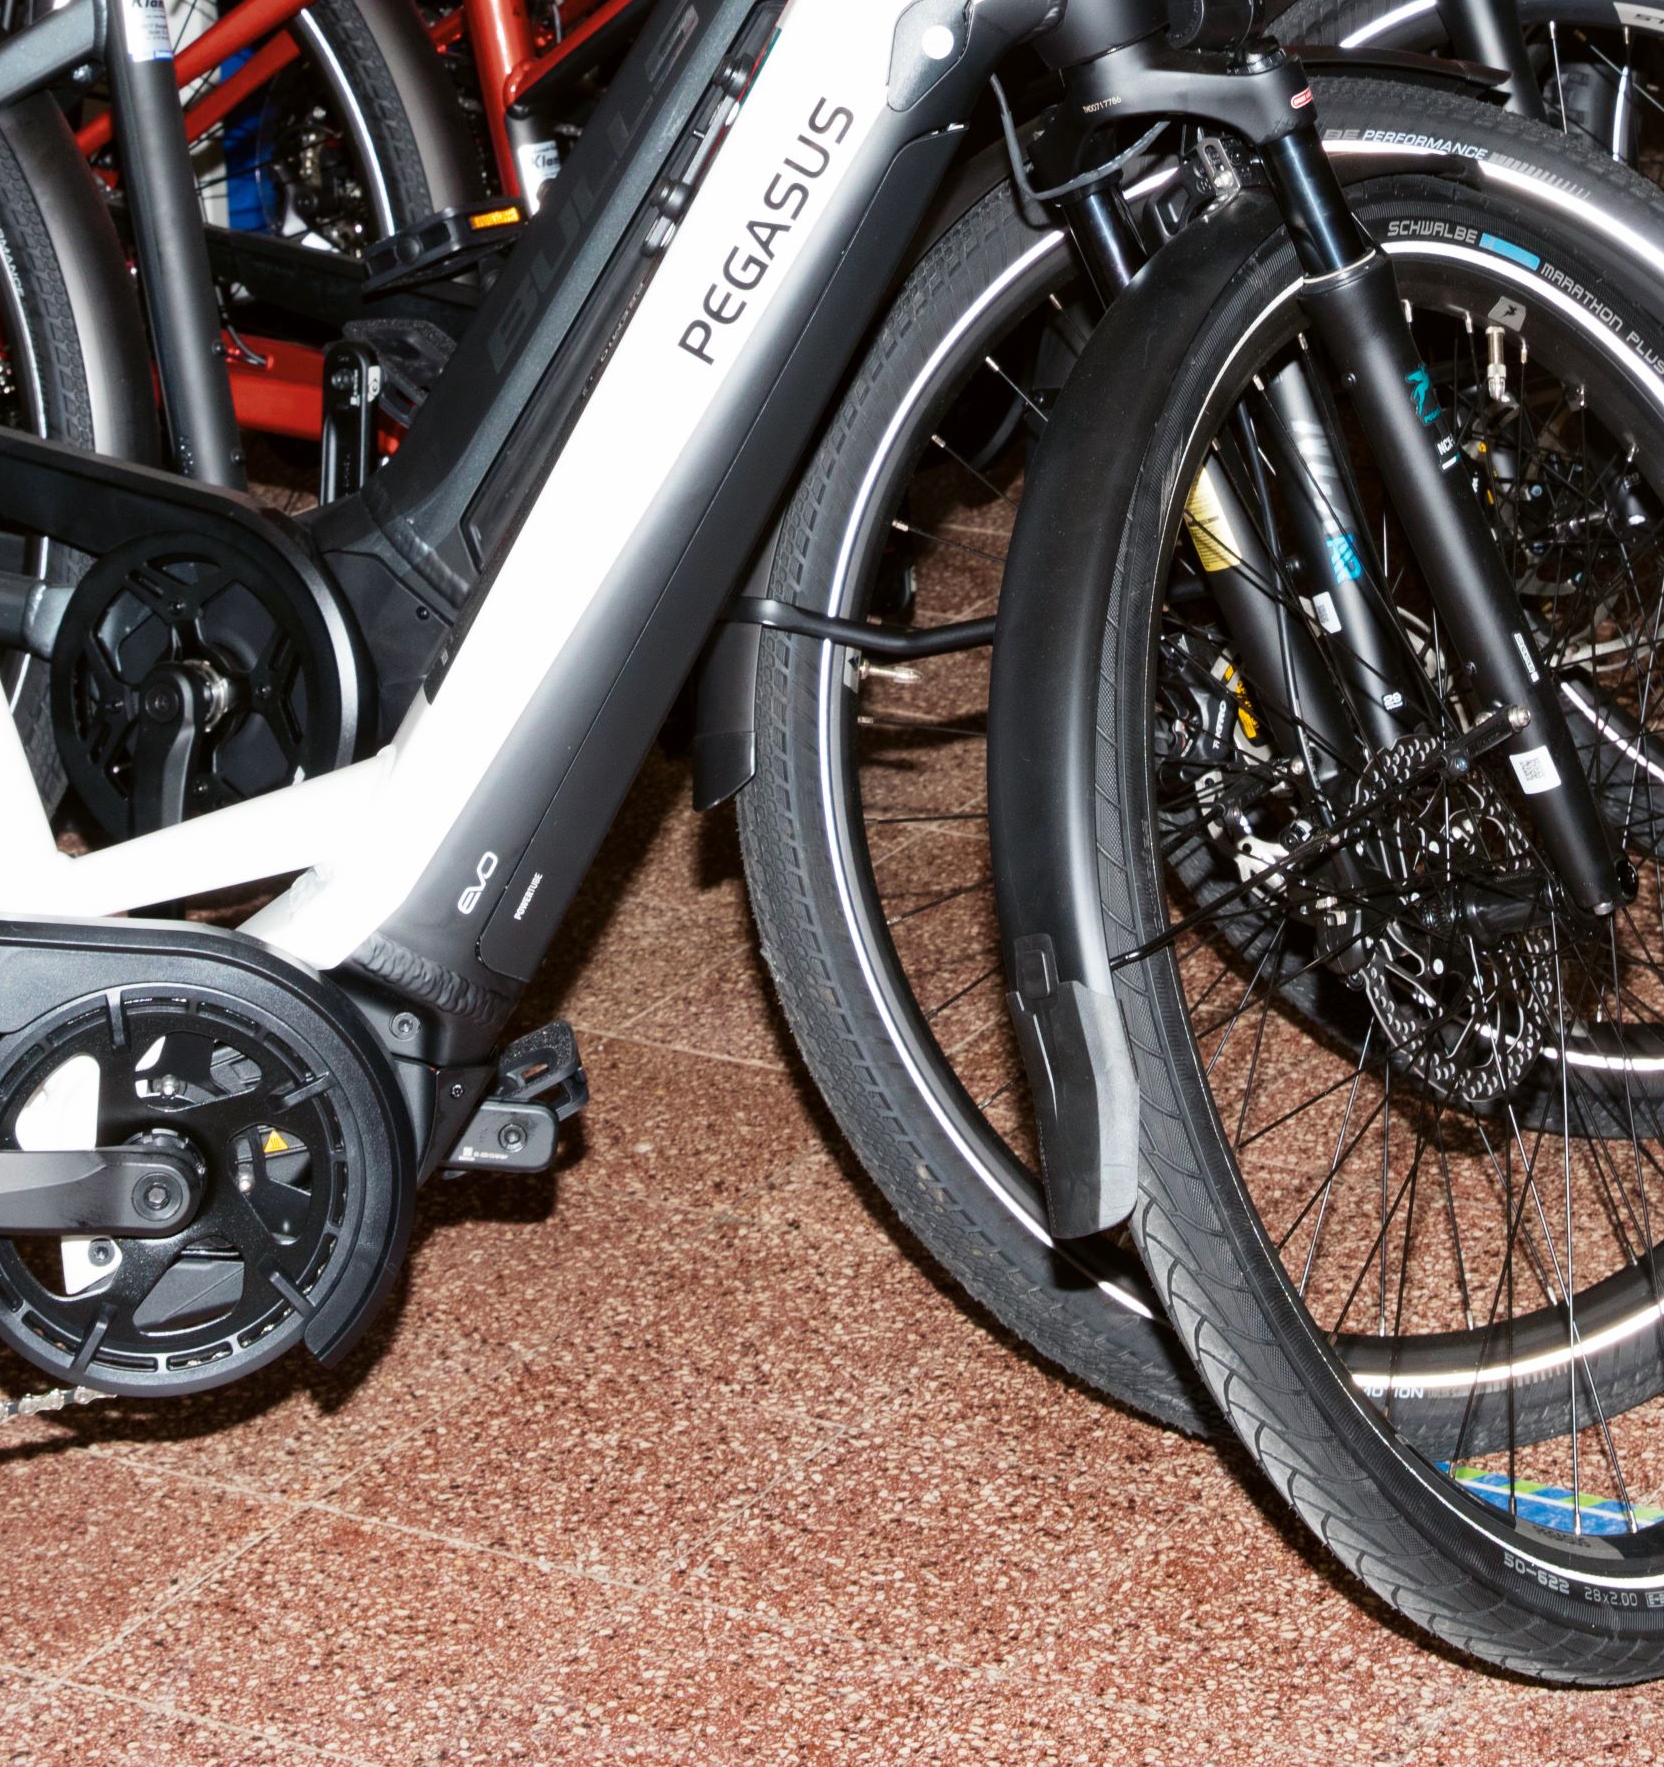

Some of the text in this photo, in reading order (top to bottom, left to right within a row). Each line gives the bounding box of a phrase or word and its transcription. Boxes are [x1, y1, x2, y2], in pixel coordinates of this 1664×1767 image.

[1362, 127, 1489, 162] PERFORMANCE
[677, 96, 855, 366] PEGASUS
[1387, 219, 1479, 246] SCHWALBE
[1539, 261, 1625, 333] MARATHON
[457, 850, 499, 915] EVO
[513, 871, 544, 921] POWERTUBE
[1503, 1549, 1571, 1596] 50-622
[1584, 1584, 1638, 1608] 28x2.00
